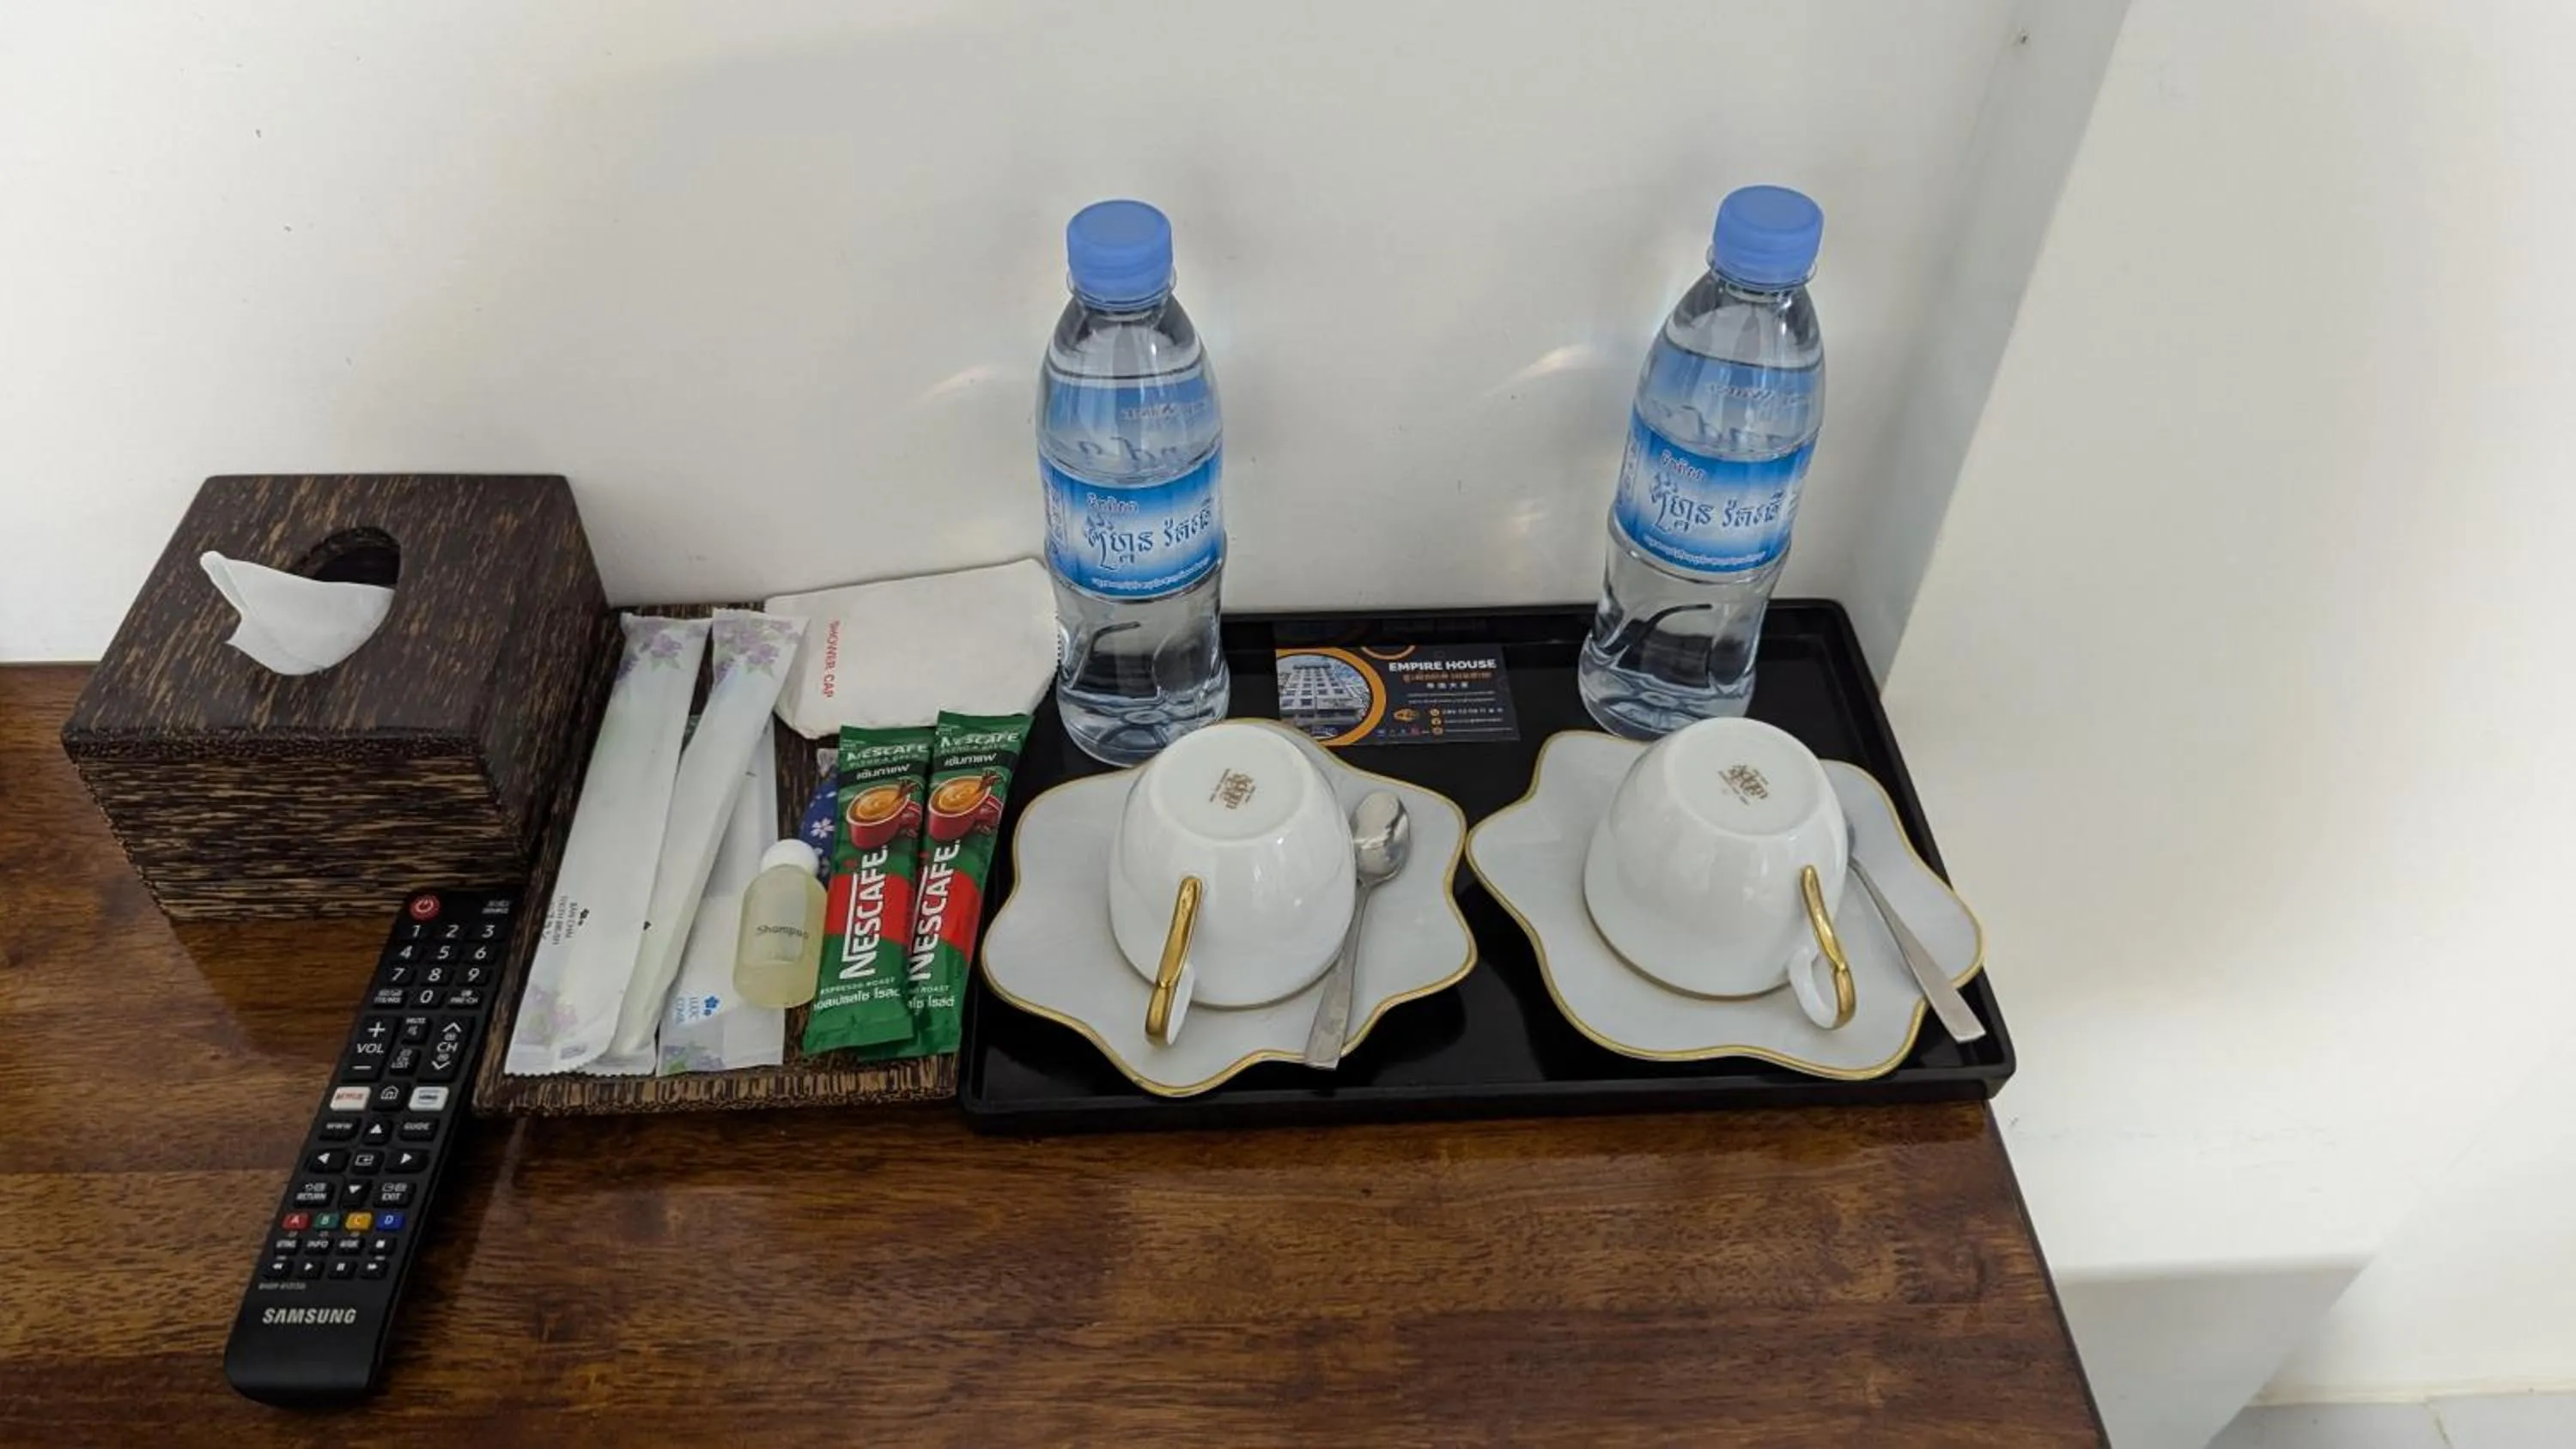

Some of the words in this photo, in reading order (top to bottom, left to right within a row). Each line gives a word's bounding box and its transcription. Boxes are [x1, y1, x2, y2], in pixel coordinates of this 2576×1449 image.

[1388, 661, 1443, 672] EMPIRE
[1445, 658, 1497, 670] HOUSE
[823, 674, 836, 698] CAP
[412, 925, 421, 937] 1
[446, 925, 459, 938] 2
[482, 925, 495, 938] 3
[399, 946, 412, 959] 4
[437, 946, 450, 960] 5
[475, 946, 487, 960] 6
[392, 967, 405, 981] 7
[428, 967, 442, 981] 8
[468, 967, 480, 982] 9
[420, 990, 433, 1003] 0
[356, 1043, 384, 1053] VOL
[436, 1042, 459, 1052] CH
[262, 1307, 357, 1325] SAMSUNG
